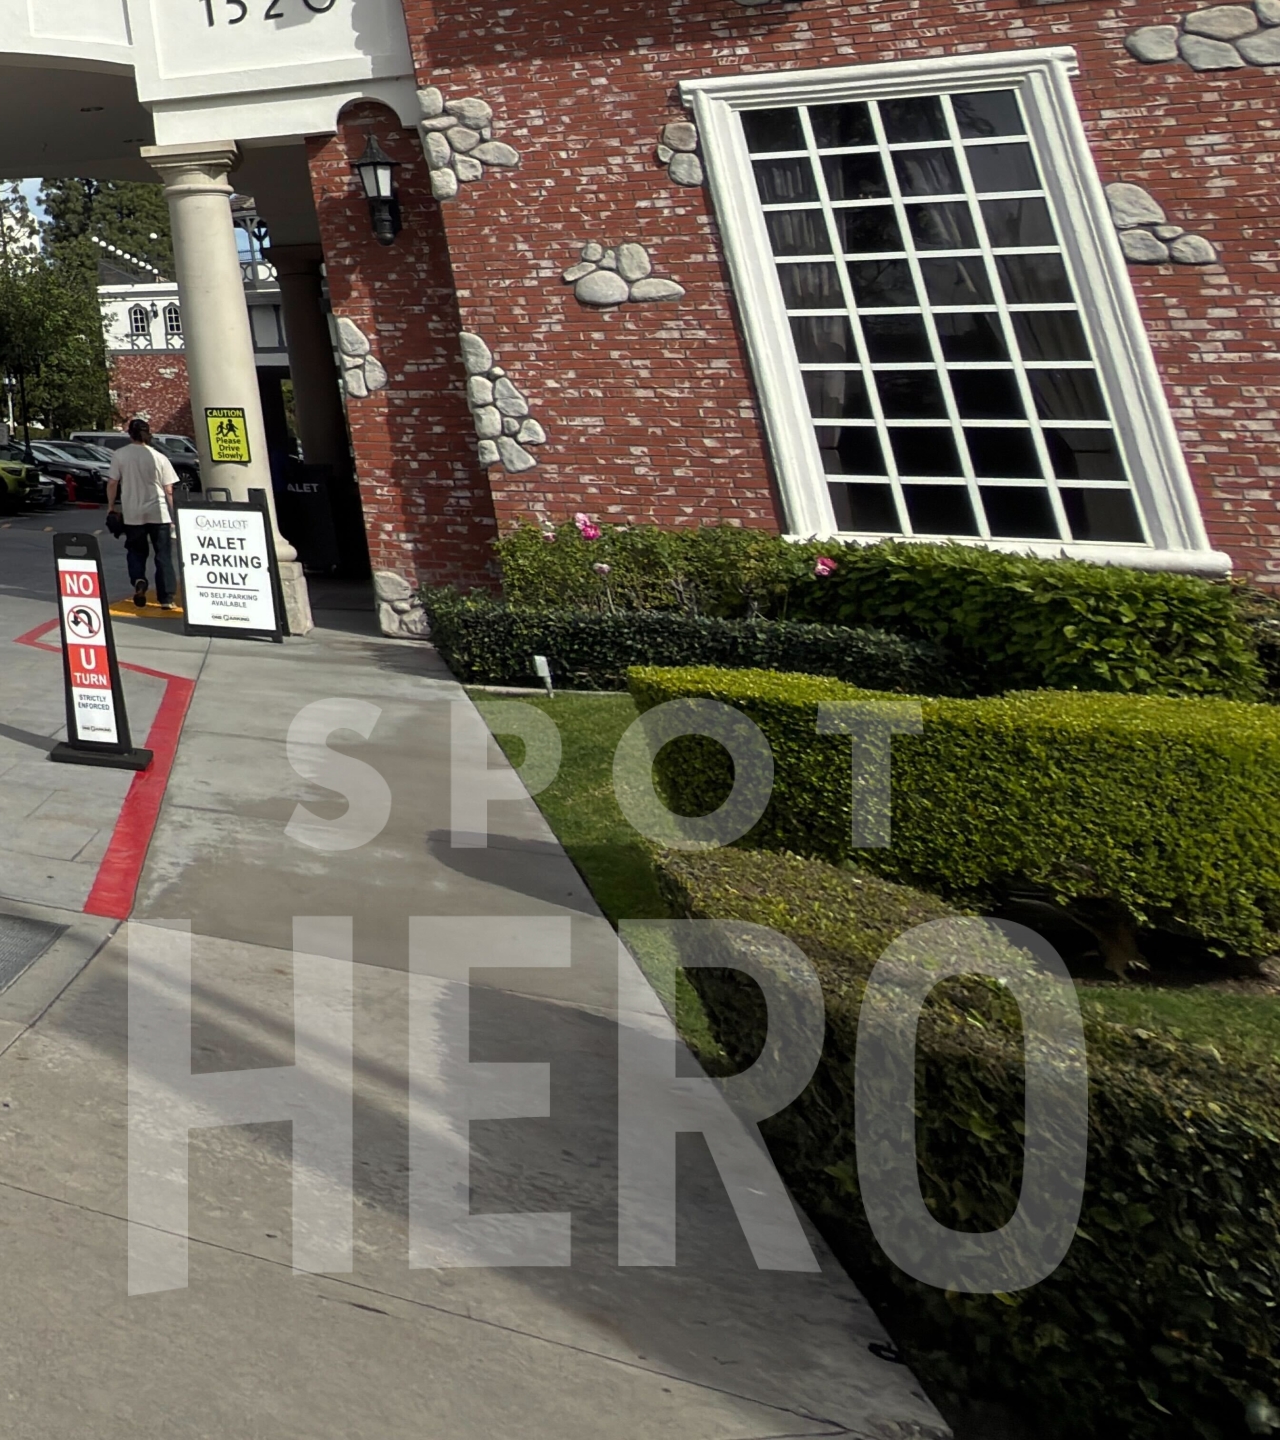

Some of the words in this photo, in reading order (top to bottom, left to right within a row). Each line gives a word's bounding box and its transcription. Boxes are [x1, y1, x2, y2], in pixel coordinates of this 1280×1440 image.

[207, 409, 243, 417] CAUTION
[216, 437, 241, 445] Please
[219, 444, 240, 452] Drive
[218, 451, 243, 461] Slowly
[287, 483, 319, 493] ALET
[195, 515, 248, 530] CAMELOT
[197, 535, 246, 550] VALET
[190, 552, 262, 569] PARKING
[206, 571, 248, 586] ONLY
[65, 573, 93, 595] NO
[199, 591, 209, 599] NO
[210, 592, 258, 601] SELF-PARKING
[211, 599, 247, 609] AVAILABLE
[80, 648, 96, 669] U
[74, 672, 107, 686] TURN
[79, 694, 107, 703] STRICTLY
[78, 702, 110, 711] ENFORCED
